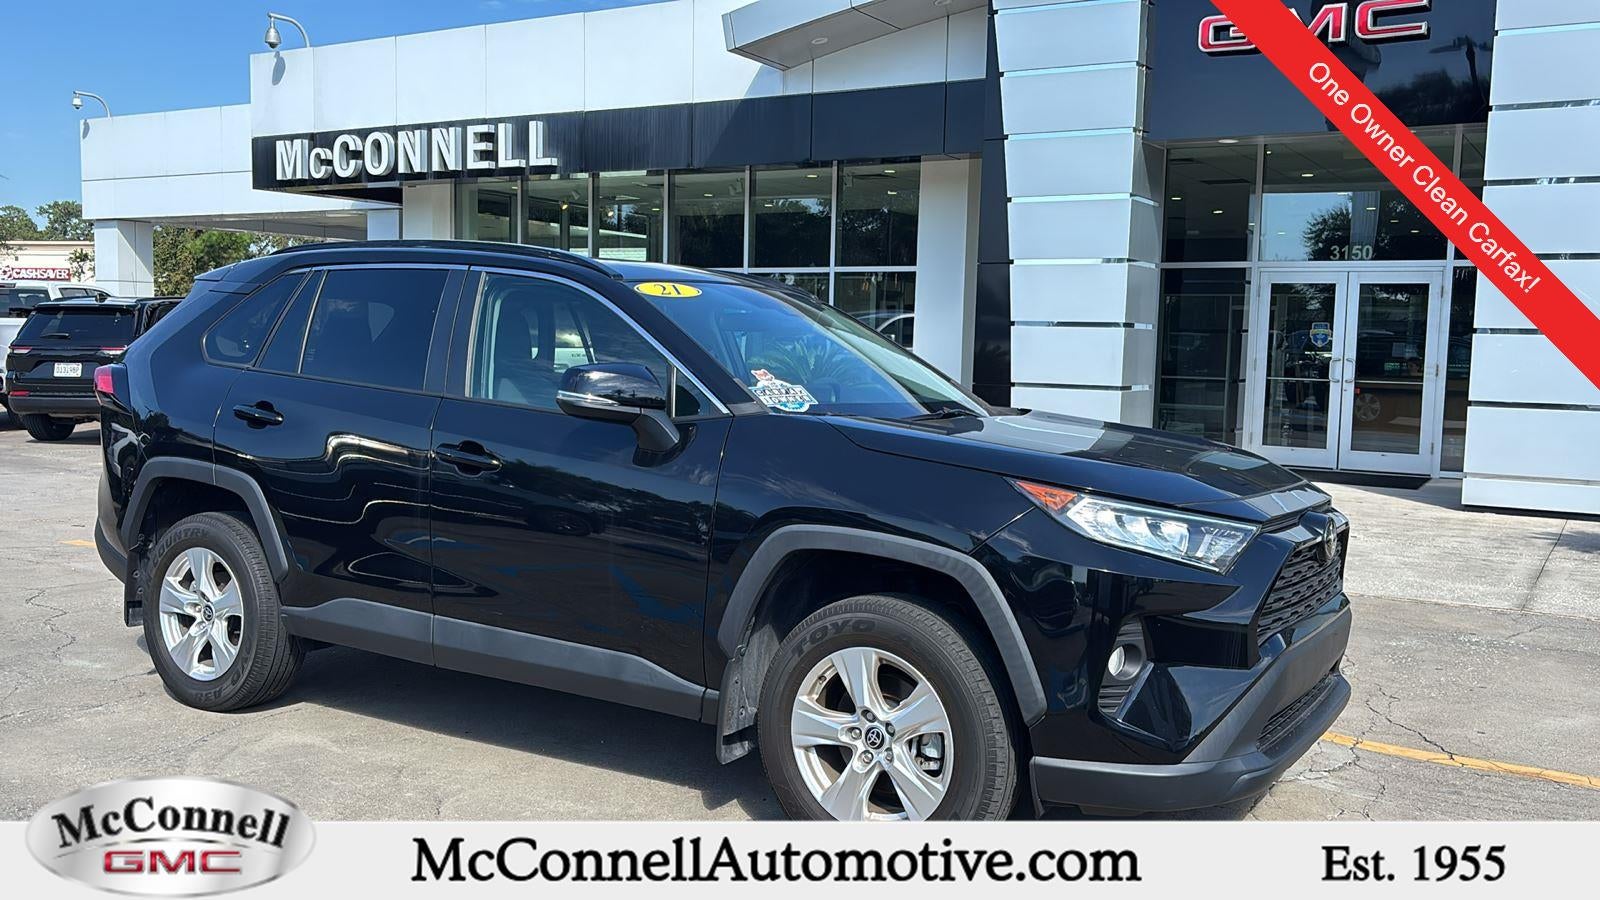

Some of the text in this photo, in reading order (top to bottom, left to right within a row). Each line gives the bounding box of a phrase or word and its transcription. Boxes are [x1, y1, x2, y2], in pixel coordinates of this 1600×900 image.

[1330, 245, 1373, 261] 3150
[12, 268, 69, 279] CASHSAVER
[653, 283, 683, 296] 21
[790, 619, 876, 658] TOYO
